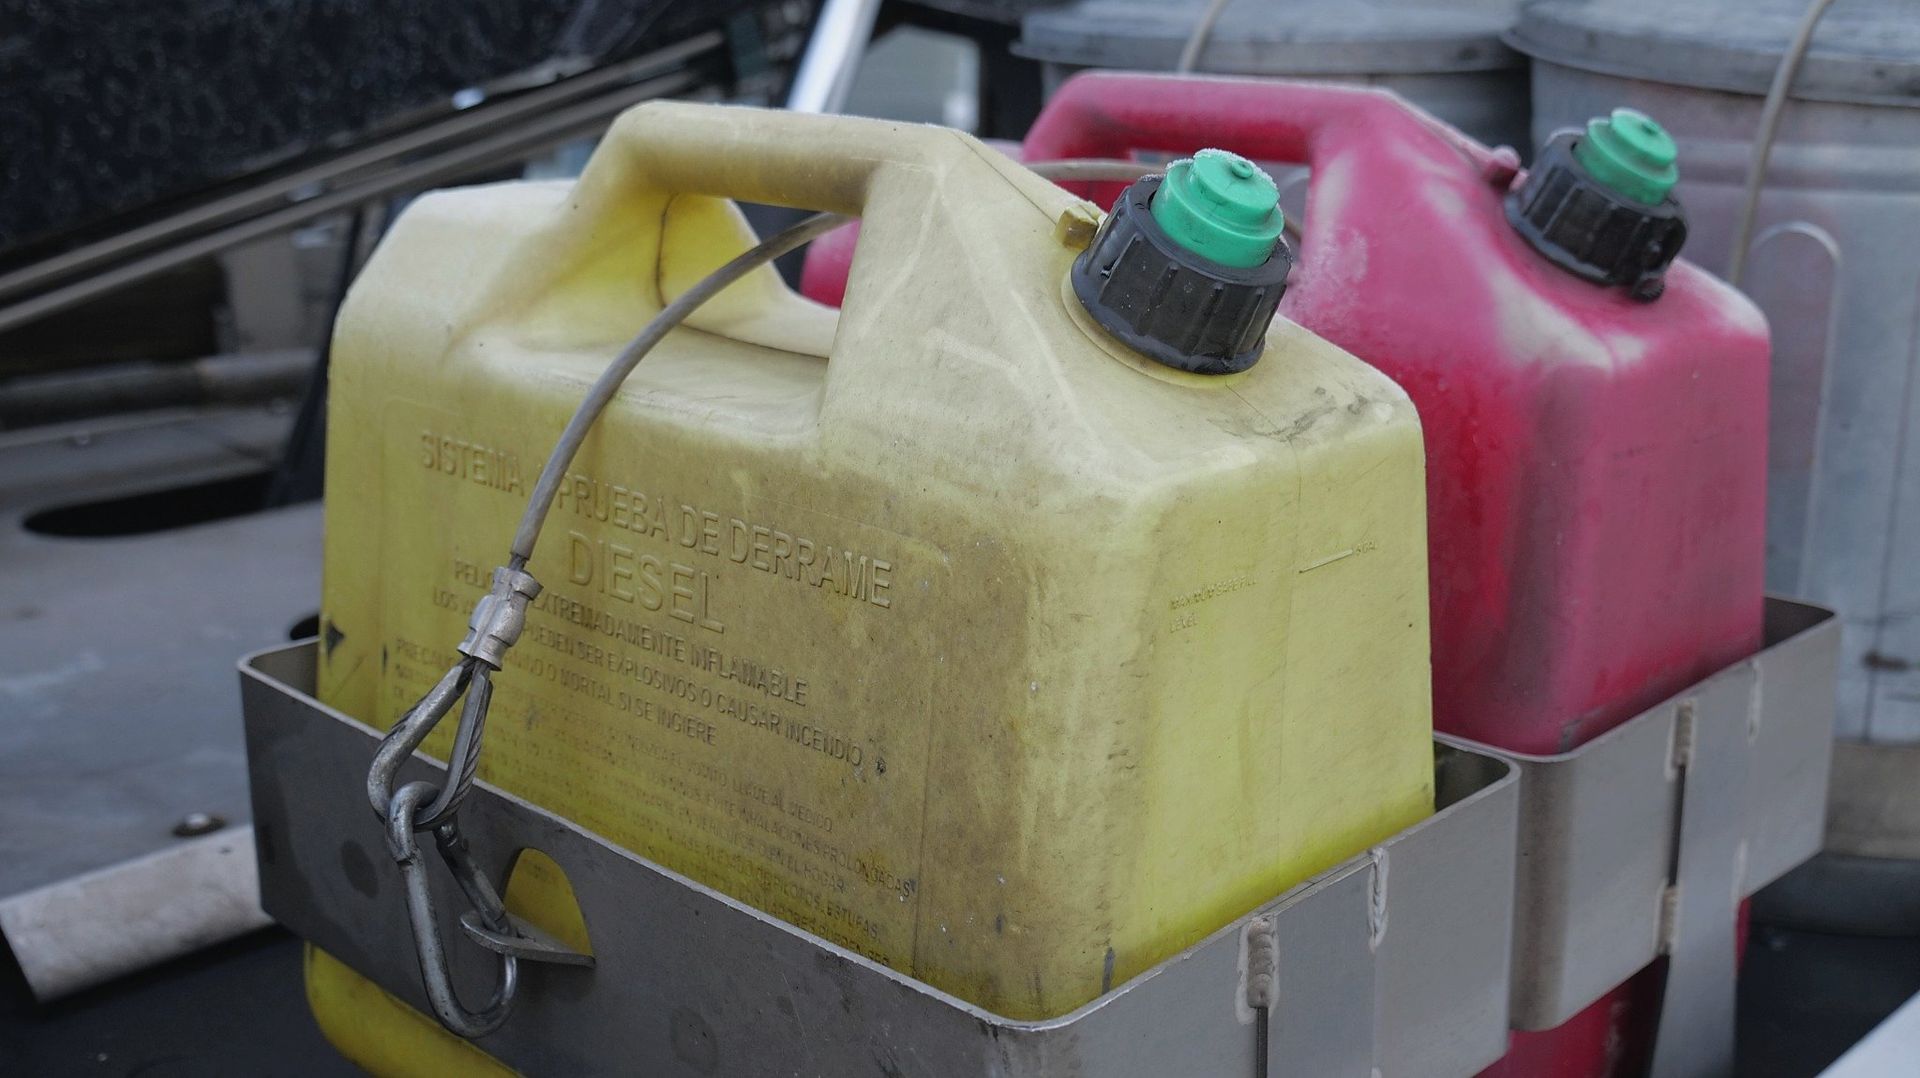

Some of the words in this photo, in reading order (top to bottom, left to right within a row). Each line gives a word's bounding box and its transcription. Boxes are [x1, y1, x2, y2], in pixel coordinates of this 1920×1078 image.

[420, 430, 524, 498] SISTEMA
[557, 472, 670, 543] PRUEBA
[679, 503, 719, 557] DE
[729, 517, 892, 609] DERRAME
[567, 530, 725, 635] DIESEL
[577, 640, 604, 668] SER
[607, 650, 697, 703] EXPLOSIVOS
[701, 686, 713, 709] O
[717, 692, 781, 736] CAUSAR
[785, 718, 864, 768] INCENDIO
[619, 691, 632, 713] SI
[635, 697, 653, 720] SE
[656, 706, 718, 747] INGIERE
[690, 642, 808, 707] INFLAMABLE
